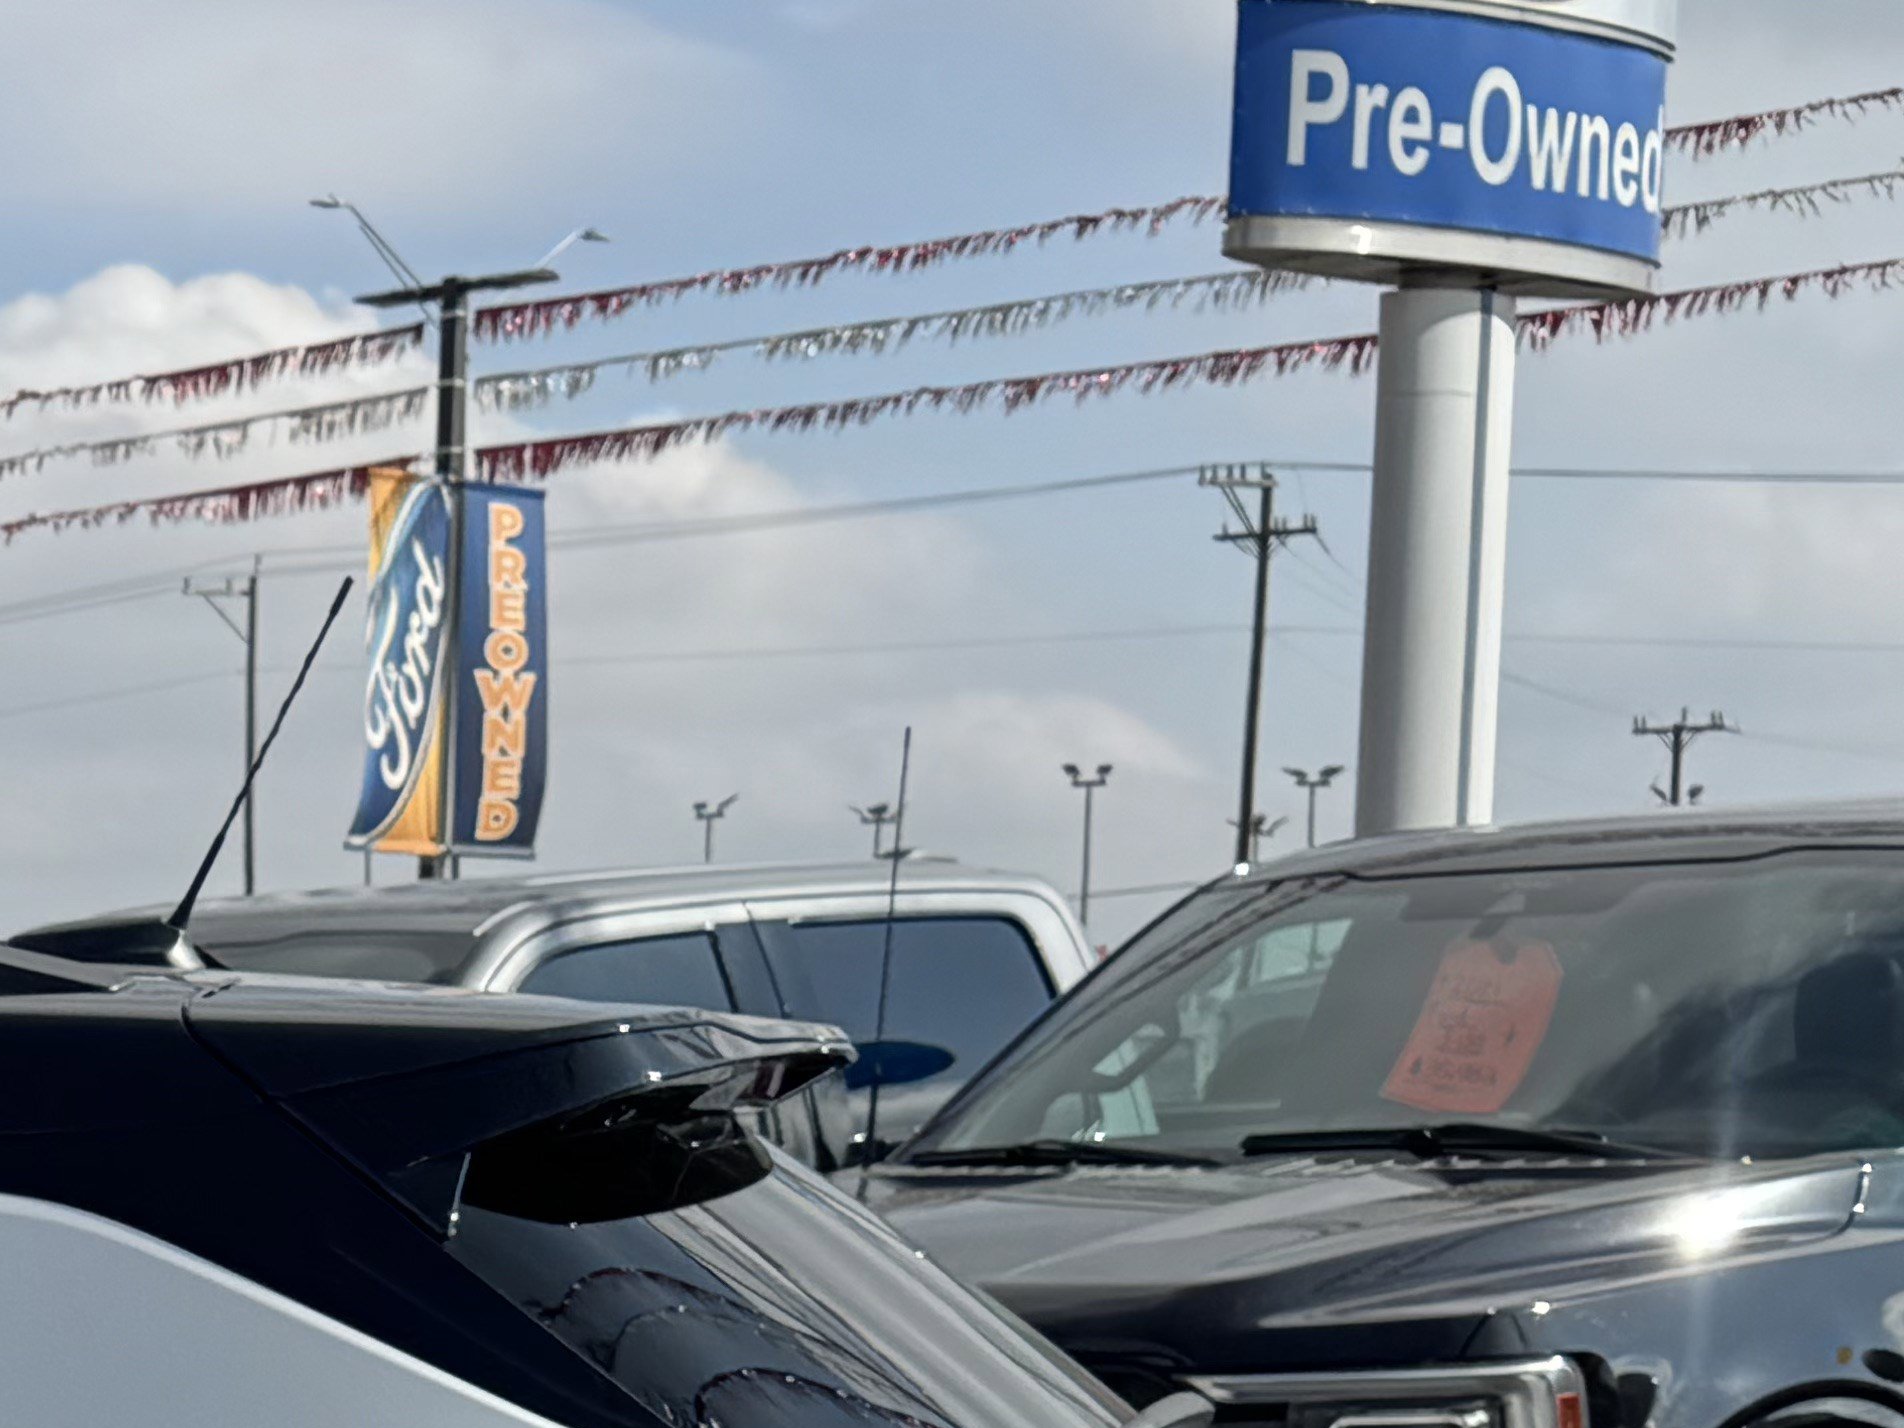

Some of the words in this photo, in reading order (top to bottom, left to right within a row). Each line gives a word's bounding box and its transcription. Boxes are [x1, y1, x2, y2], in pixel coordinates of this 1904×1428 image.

[1285, 48, 1664, 215] Pre-Owned
[364, 536, 445, 791] Ford
[473, 502, 538, 842] PREOWNED
